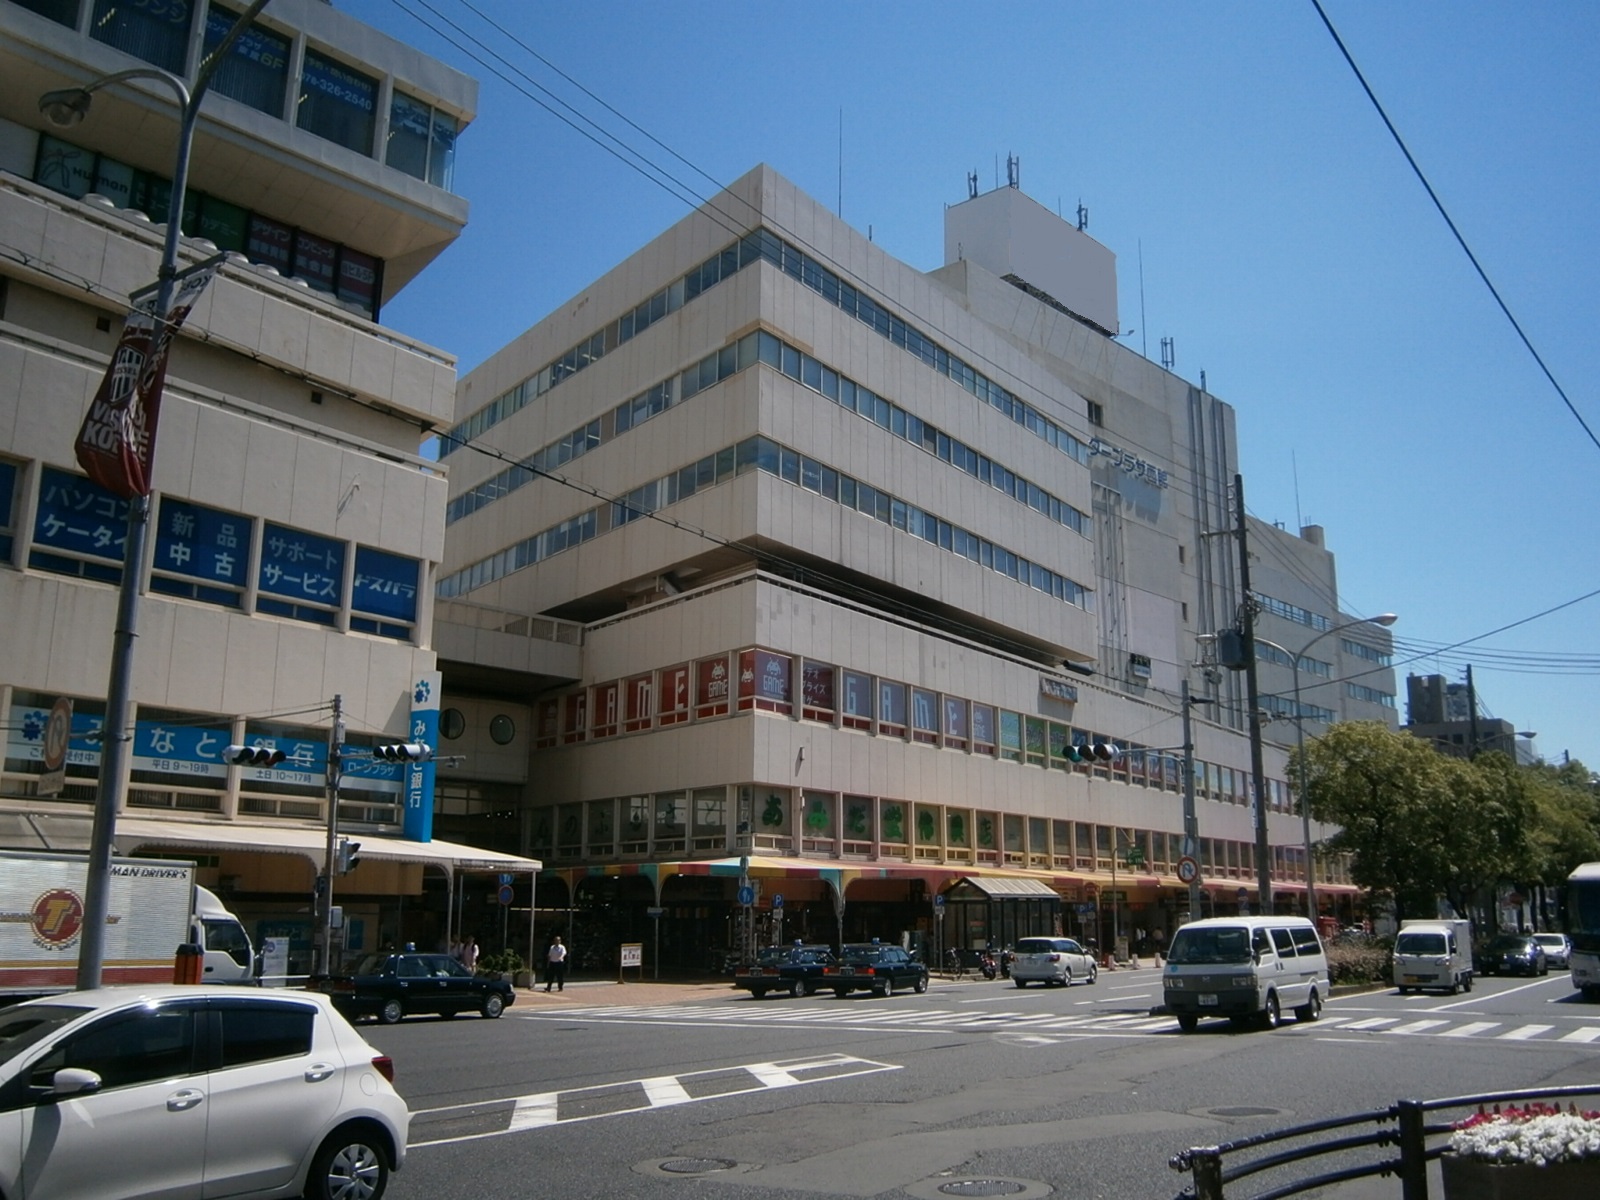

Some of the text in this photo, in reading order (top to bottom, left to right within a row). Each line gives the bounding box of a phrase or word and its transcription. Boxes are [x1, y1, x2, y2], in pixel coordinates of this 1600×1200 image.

[206, 21, 262, 50] センタプラザ
[169, 541, 236, 578] 中古
[268, 536, 338, 570] サポート
[264, 563, 337, 599] サービス
[763, 674, 784, 695] GAME
[152, 758, 170, 769] 平日
[256, 769, 273, 780] 土日
[775, 894, 782, 906] P
